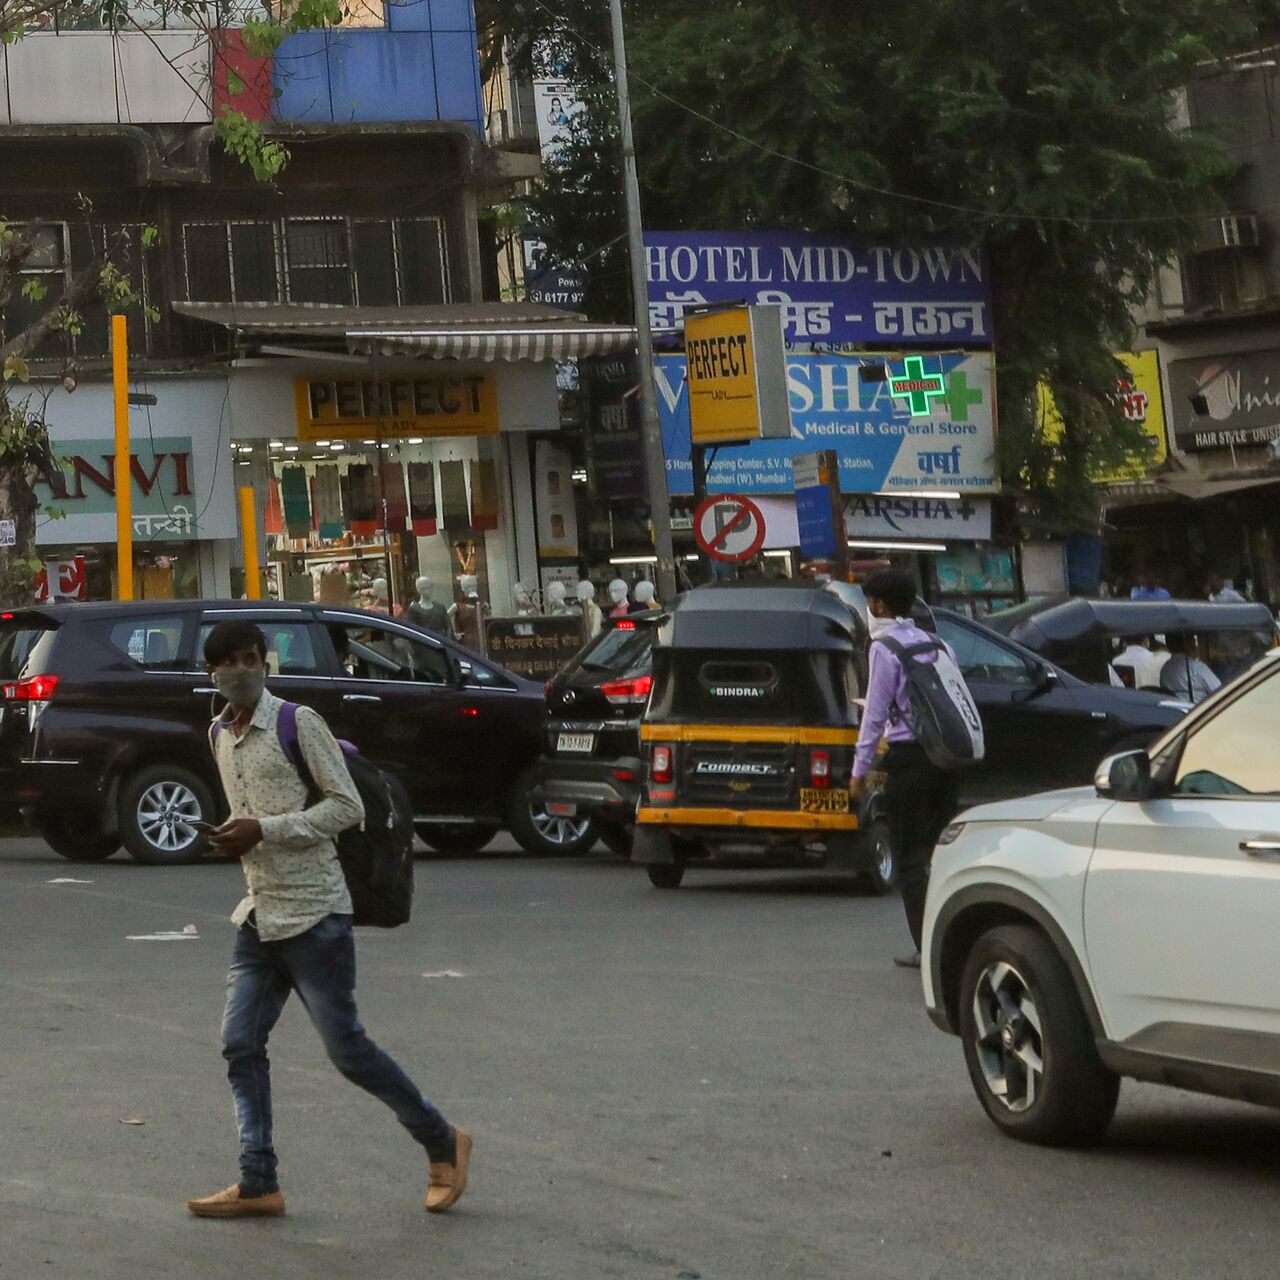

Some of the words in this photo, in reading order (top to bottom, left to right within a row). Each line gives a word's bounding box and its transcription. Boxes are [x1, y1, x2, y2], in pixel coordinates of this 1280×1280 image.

[645, 246, 772, 283] HOTEL
[780, 246, 985, 284] MID-TOWN
[544, 292, 569, 303] 6177
[872, 301, 987, 337] टाऊन
[687, 334, 748, 381] PERFECT
[653, 363, 908, 426] VSHA
[893, 380, 940, 392] MEDICAL
[307, 375, 486, 420] PERFECT
[382, 419, 418, 431] LADY
[804, 422, 861, 435] Medical
[864, 423, 876, 435] &
[879, 422, 935, 435] General
[938, 423, 977, 436] Store
[1195, 431, 1218, 447] HAIR
[1219, 429, 1247, 445] STYLE
[737, 459, 766, 470] Center,
[767, 458, 783, 469] S.V.
[843, 457, 874, 470] Station,
[916, 443, 962, 474] वर्षा
[30, 452, 192, 500] ANVI
[706, 474, 736, 484] Andheri
[755, 473, 787, 484] Mumbai
[716, 687, 759, 697] BINDRA
